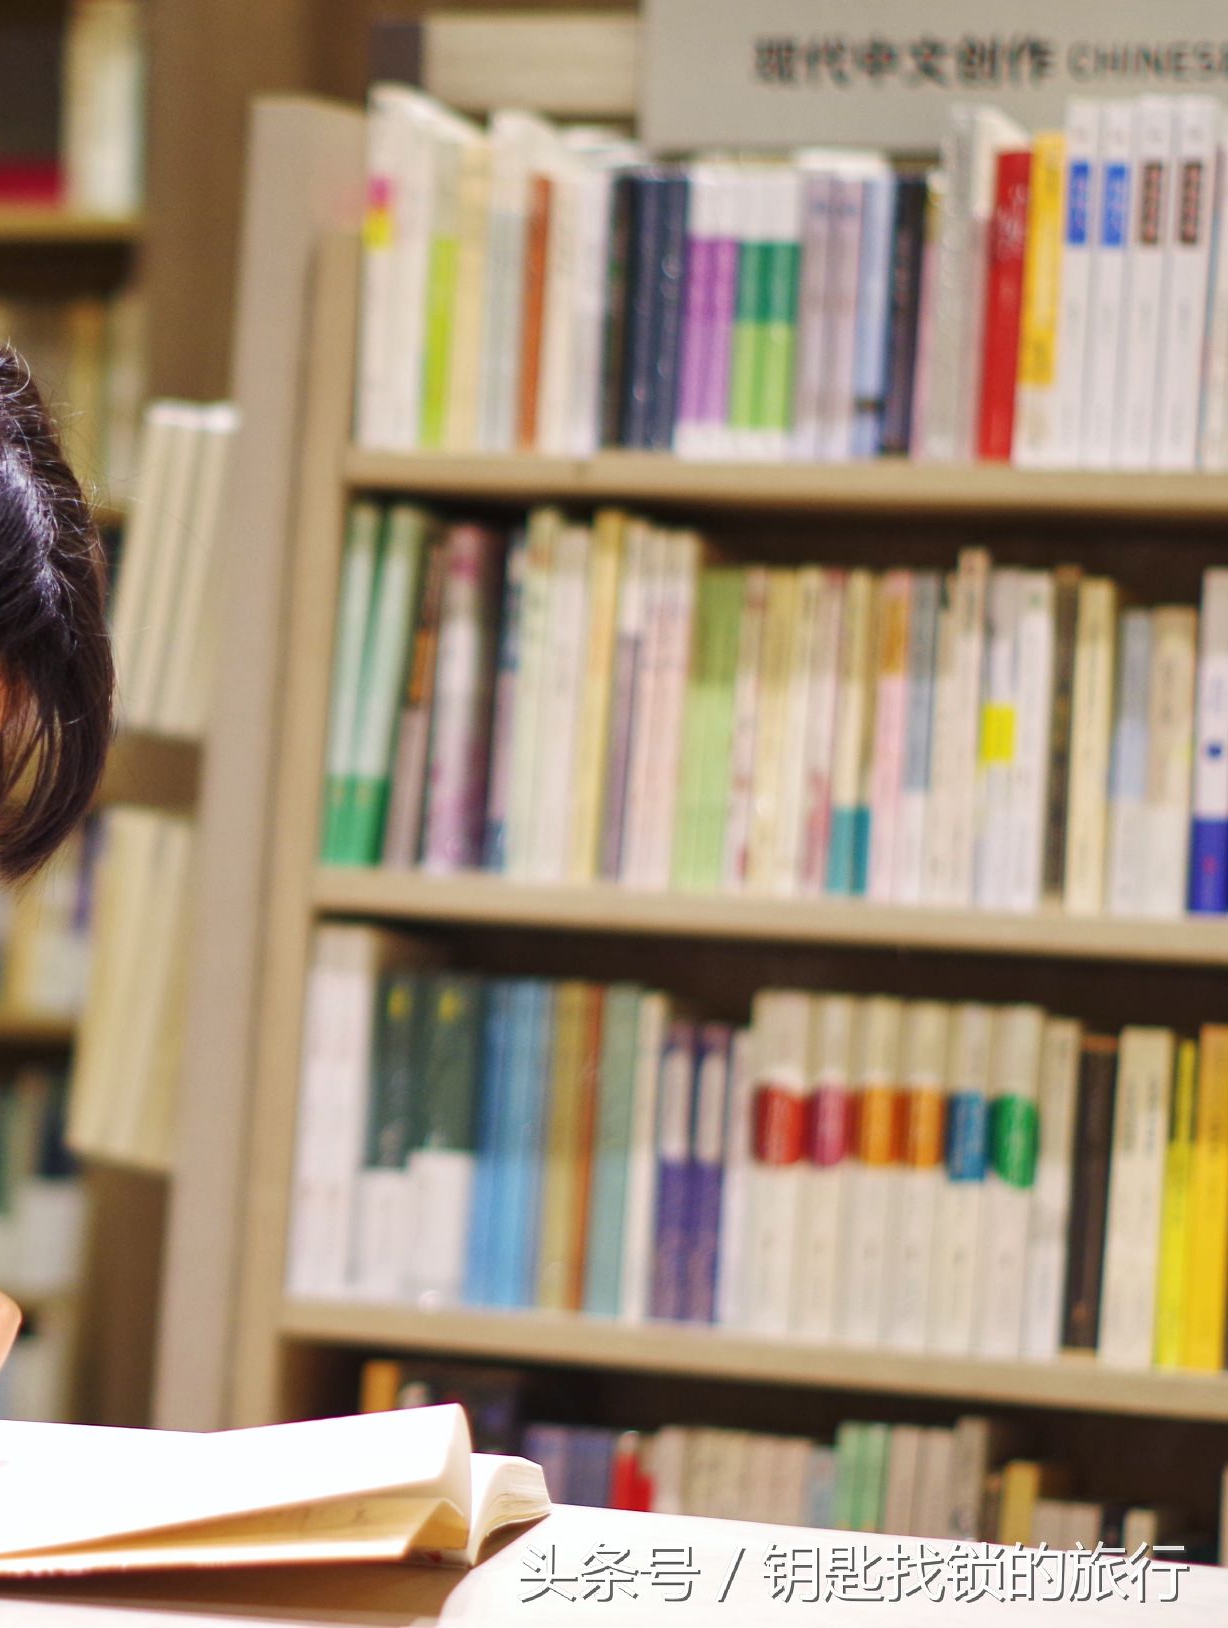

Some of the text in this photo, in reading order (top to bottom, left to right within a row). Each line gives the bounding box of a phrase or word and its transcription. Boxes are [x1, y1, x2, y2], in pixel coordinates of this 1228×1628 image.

[754, 36, 1054, 86] 现代中文创作
